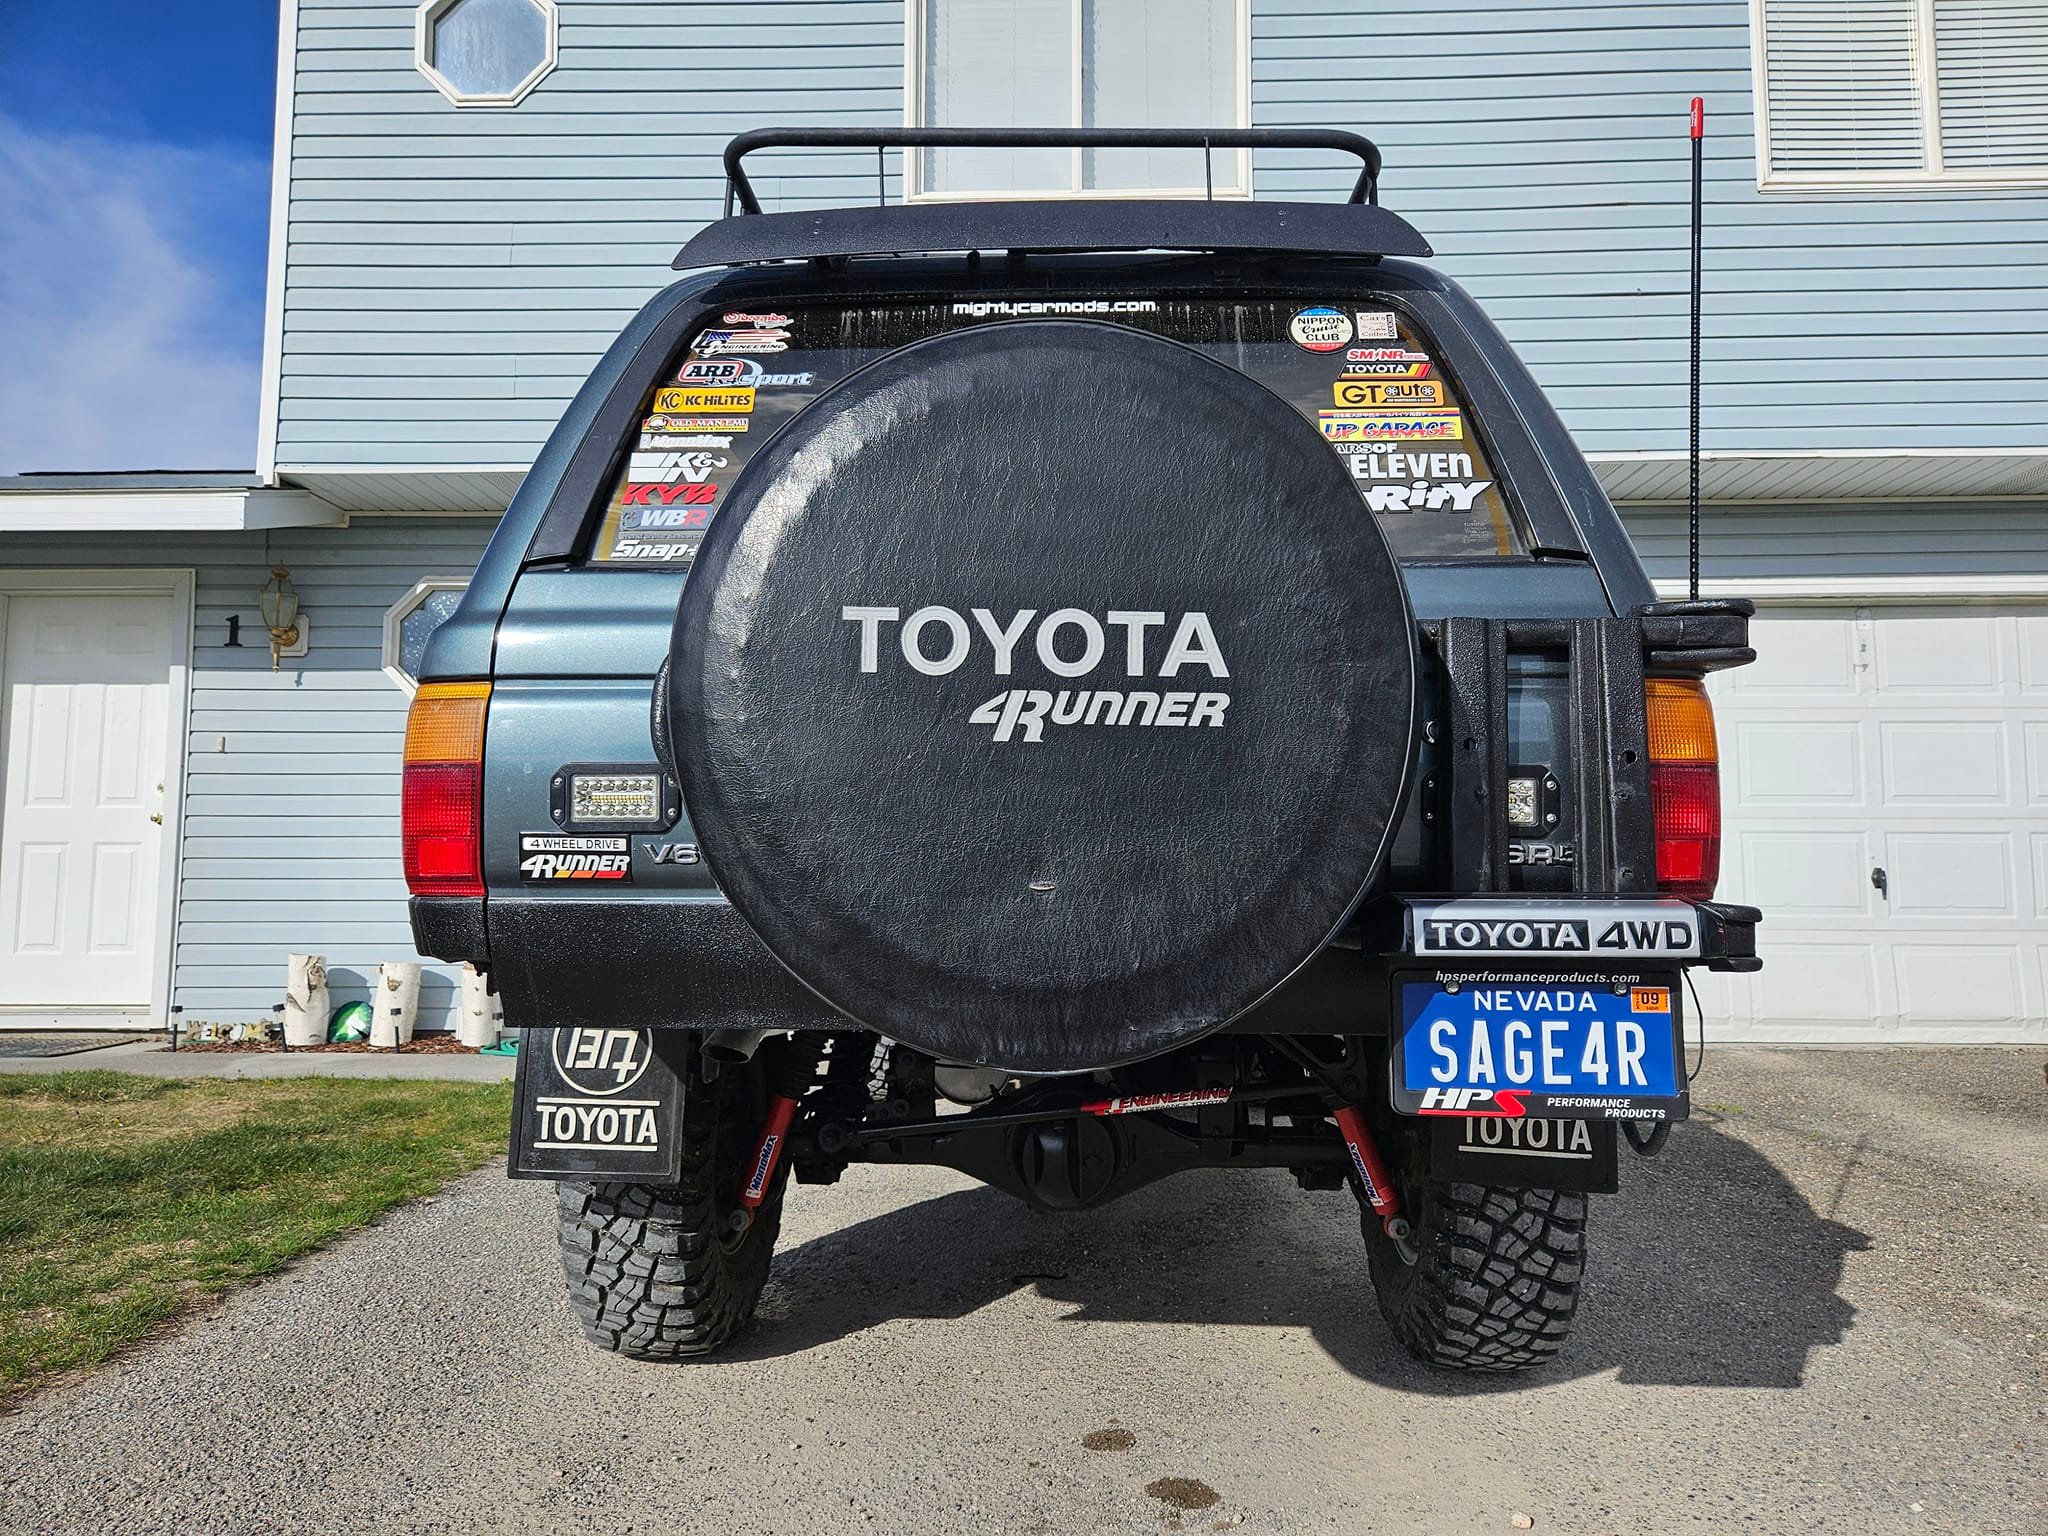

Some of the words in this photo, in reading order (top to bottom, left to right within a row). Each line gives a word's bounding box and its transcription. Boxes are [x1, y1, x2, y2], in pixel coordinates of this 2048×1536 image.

[953, 300, 1156, 316] mightycarmods.com
[739, 312, 787, 323] brembo
[1297, 316, 1345, 325] NIPPON
[1302, 322, 1340, 334] Cruise
[1305, 333, 1340, 342] CLUB
[686, 365, 736, 378] ARB
[1346, 364, 1407, 374] TOYOTA
[660, 391, 681, 409] KC
[685, 395, 702, 406] KC
[1342, 385, 1382, 404] GT
[671, 419, 694, 428] OLD
[696, 419, 723, 428] MAN
[1324, 422, 1359, 439] UP
[1362, 420, 1457, 438] GARAGE
[622, 483, 719, 506] KYB
[641, 509, 708, 527] WBR
[610, 539, 699, 561] Snap-
[224, 614, 243, 647] 1
[842, 605, 1230, 678] TOYOTA
[530, 839, 541, 849] 4
[543, 838, 583, 849] WHEEL
[586, 838, 620, 849] DRIVE
[643, 843, 700, 864] V6
[1431, 922, 1584, 950] TOYOTA
[1596, 920, 1693, 950] 4WD
[1435, 970, 1640, 983] hpsperformanceproducts.com
[1474, 990, 1597, 1012] NEVADA
[1641, 992, 1659, 1005] 09
[1430, 1019, 1648, 1086] SAGE4R
[1119, 1087, 1232, 1109] ENGINEERING
[1418, 1087, 1533, 1117] HPS
[1547, 1097, 1632, 1109] PERFORMANCE
[1604, 1108, 1666, 1119] PRODUCTS
[536, 1105, 659, 1143] TOYOTA
[1466, 1117, 1592, 1151] TOYOTA
[751, 1135, 778, 1191] MonoMax
